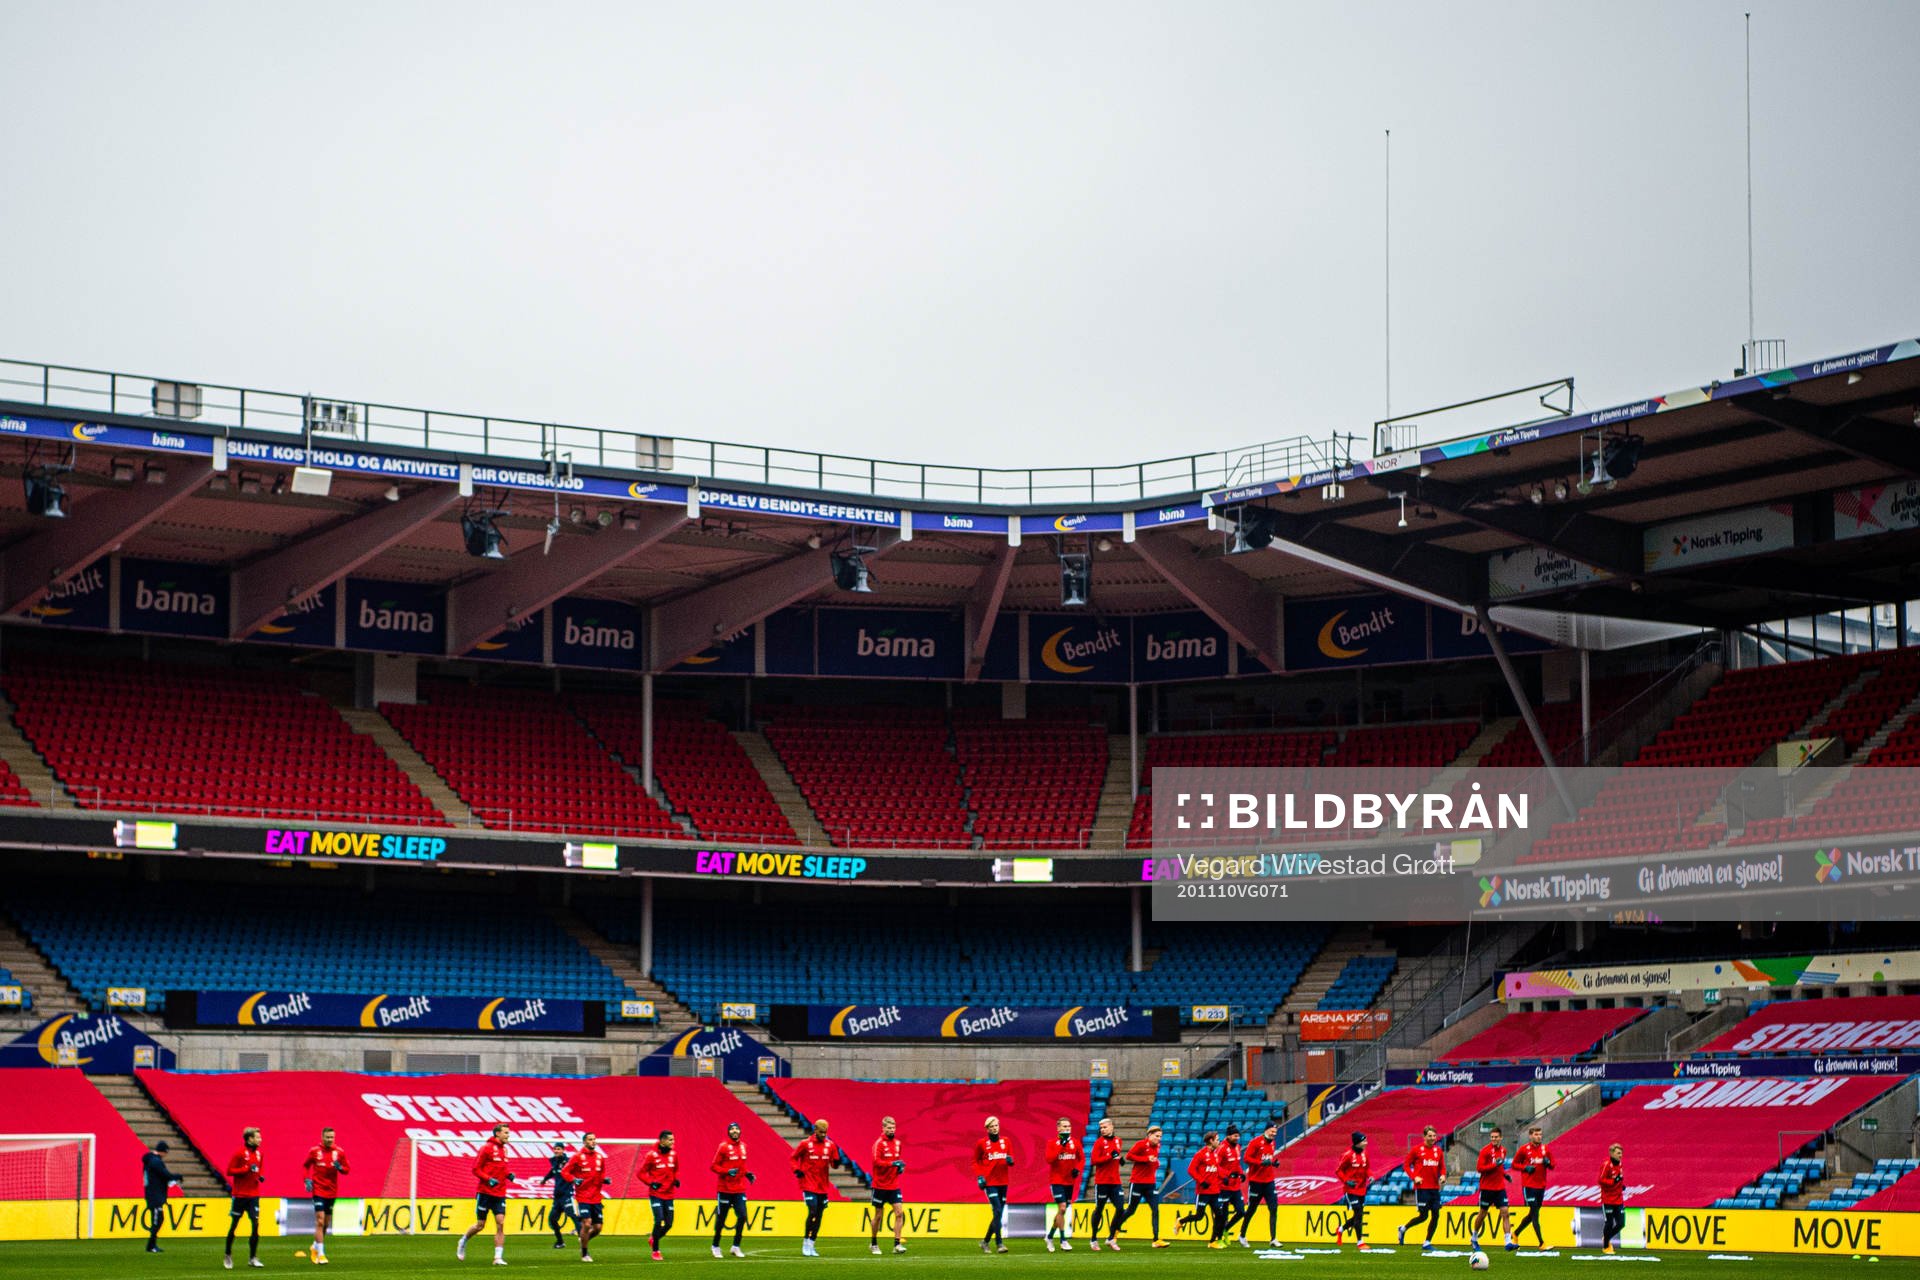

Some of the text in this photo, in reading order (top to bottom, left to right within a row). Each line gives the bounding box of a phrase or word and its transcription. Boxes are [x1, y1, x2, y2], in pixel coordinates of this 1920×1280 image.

[0, 419, 27, 432] ama
[152, 432, 186, 448] bama
[227, 441, 459, 478] SUNT KOSTHOLD OG AKTIVITET
[472, 469, 497, 482] GIR
[699, 491, 895, 524] OPPLEV BENDIT-EFFEKTEN
[944, 515, 973, 528] bama
[1159, 508, 1185, 521] bama
[1691, 527, 1763, 549] Norsk Tipping
[136, 579, 215, 616] bama
[359, 598, 434, 633] bama
[1337, 607, 1396, 646] Bendit
[564, 616, 635, 650] bama
[856, 628, 936, 658] bama
[1063, 628, 1121, 661] Bendit
[1146, 633, 1217, 661] bama
[265, 830, 446, 860] EAT MOVE SLEEP
[695, 851, 867, 879] EAT MOVE SLEEP
[1141, 857, 1184, 881] EAT
[1638, 854, 1784, 894] Gi drømmen en sjanse!
[1846, 848, 1903, 876] Norsk
[1505, 873, 1611, 902] Norsk Tipping
[1583, 972, 1593, 989] Gi
[1631, 974, 1641, 985] en
[1642, 968, 1671, 988] sjanse!
[257, 992, 312, 1025] Bendit
[379, 995, 431, 1027] Bendit
[496, 998, 548, 1030] Bendit
[625, 1005, 641, 1015] 231
[848, 1005, 901, 1036] Bendit
[960, 1006, 1013, 1037] Bendit
[1075, 1006, 1128, 1036] Bendit
[1207, 1009, 1225, 1019] 233
[1301, 1013, 1345, 1024] ARENA
[60, 1015, 123, 1050] Bendit
[691, 1029, 743, 1059] Bendit
[1427, 1070, 1473, 1082] Norsk Tipping
[1686, 1063, 1741, 1077] Norsk Tipping
[1814, 1059, 1824, 1074] Gi
[1870, 1056, 1898, 1074] sjanse!
[361, 1093, 584, 1123] STERKERE
[1643, 1077, 1850, 1110] SAMMEN
[109, 1204, 207, 1232] MOVE
[362, 1204, 453, 1231] MOVE
[1646, 1214, 1727, 1245] MOVE
[1793, 1217, 1882, 1250] MOVE
